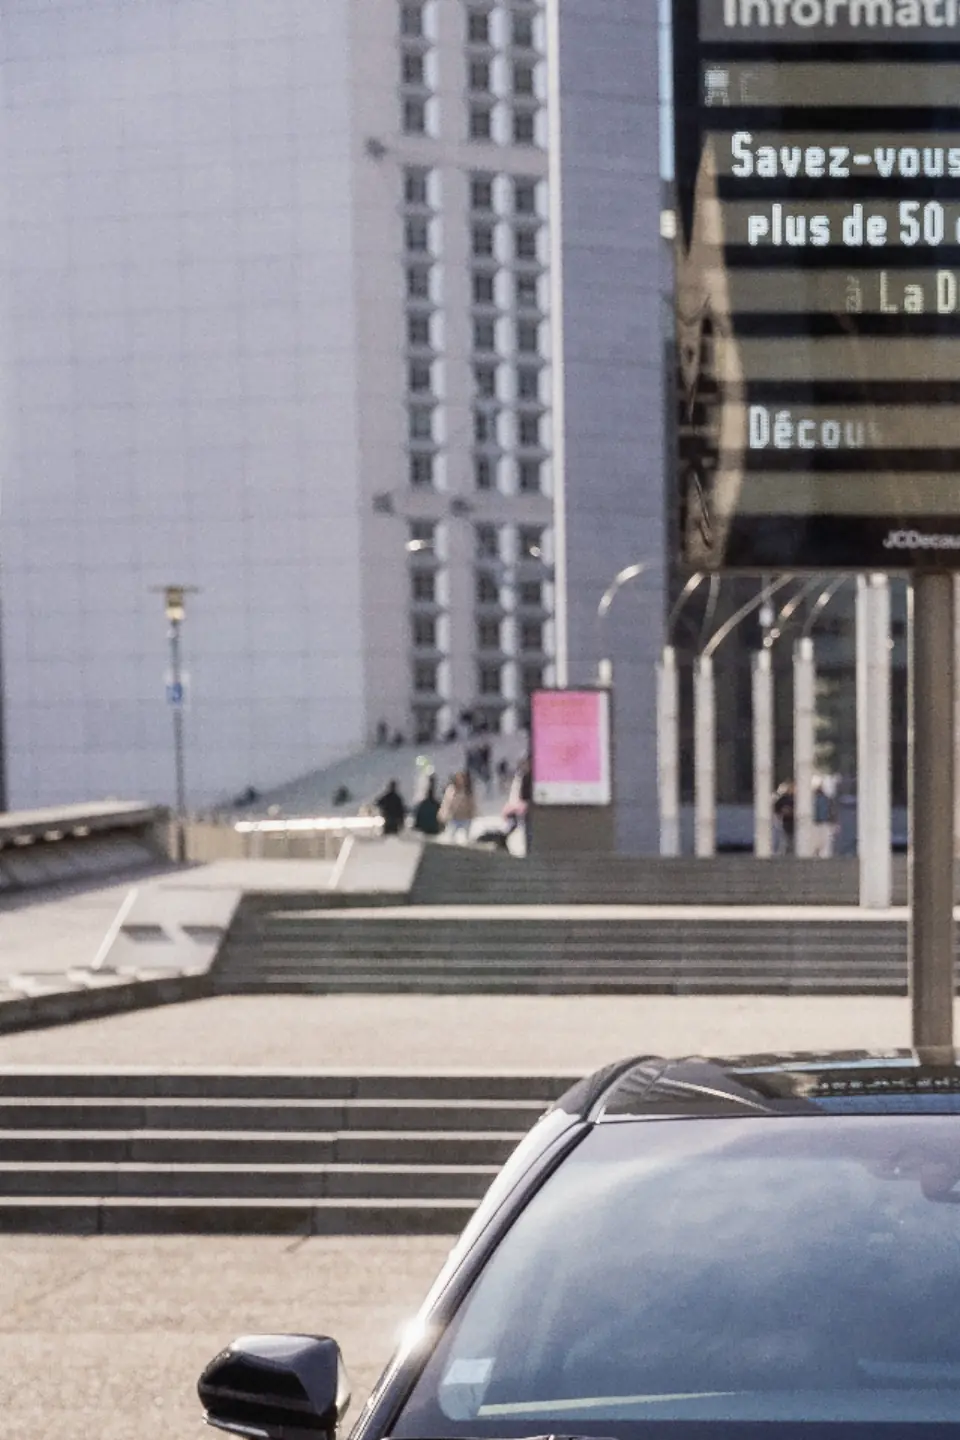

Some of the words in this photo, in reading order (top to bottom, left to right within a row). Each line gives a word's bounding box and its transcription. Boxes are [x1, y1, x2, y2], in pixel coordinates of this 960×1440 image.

[747, 203, 831, 246] plus
[842, 203, 888, 246] de
[899, 201, 945, 246] 50
[879, 271, 925, 314] La
